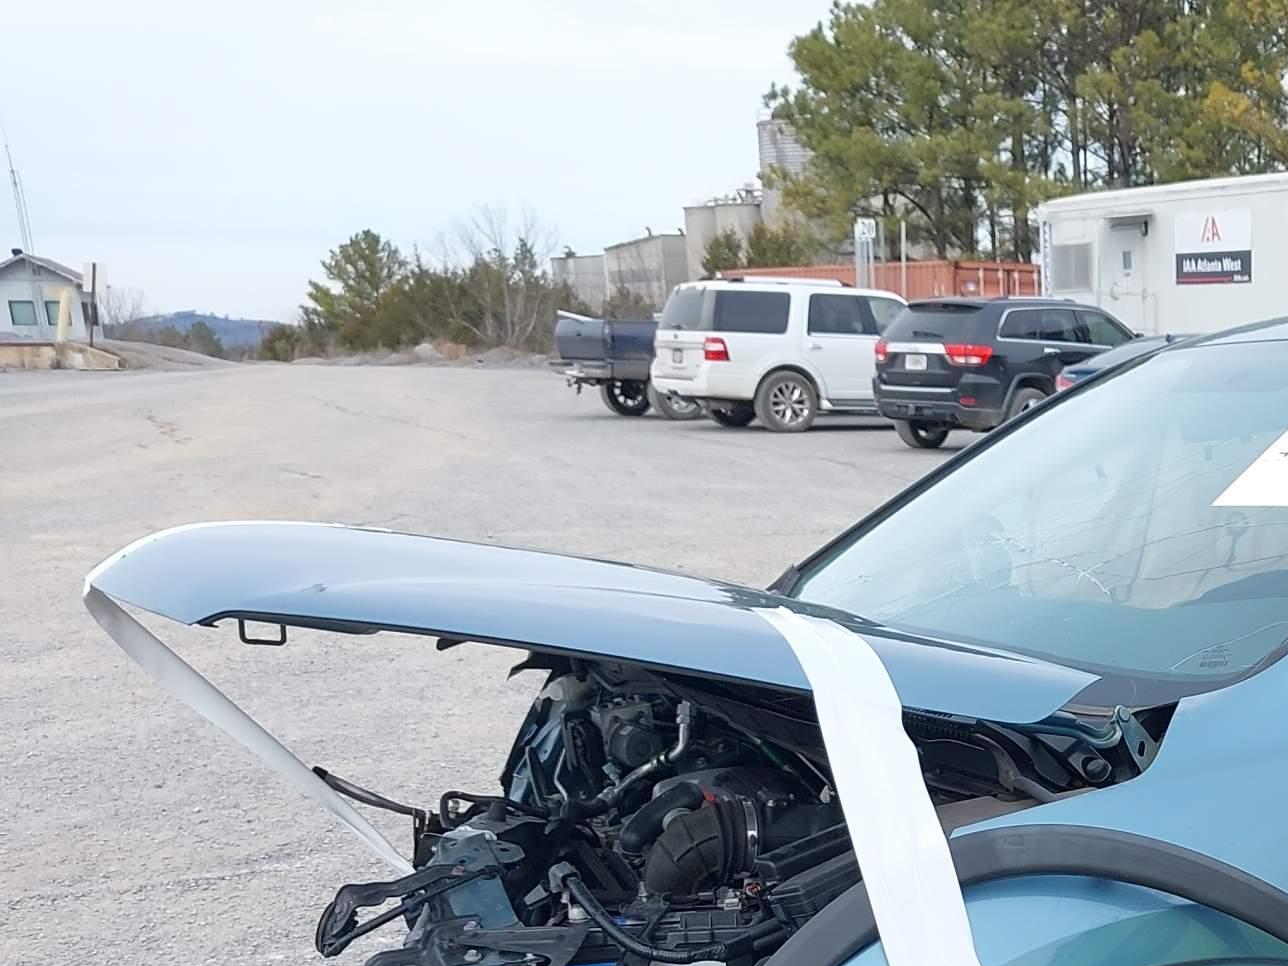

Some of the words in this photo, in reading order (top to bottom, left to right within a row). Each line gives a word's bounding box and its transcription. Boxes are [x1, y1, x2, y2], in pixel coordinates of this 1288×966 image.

[1183, 258, 1197, 272] IAA
[1197, 257, 1222, 272] Atlanta
[1222, 256, 1242, 271] West
